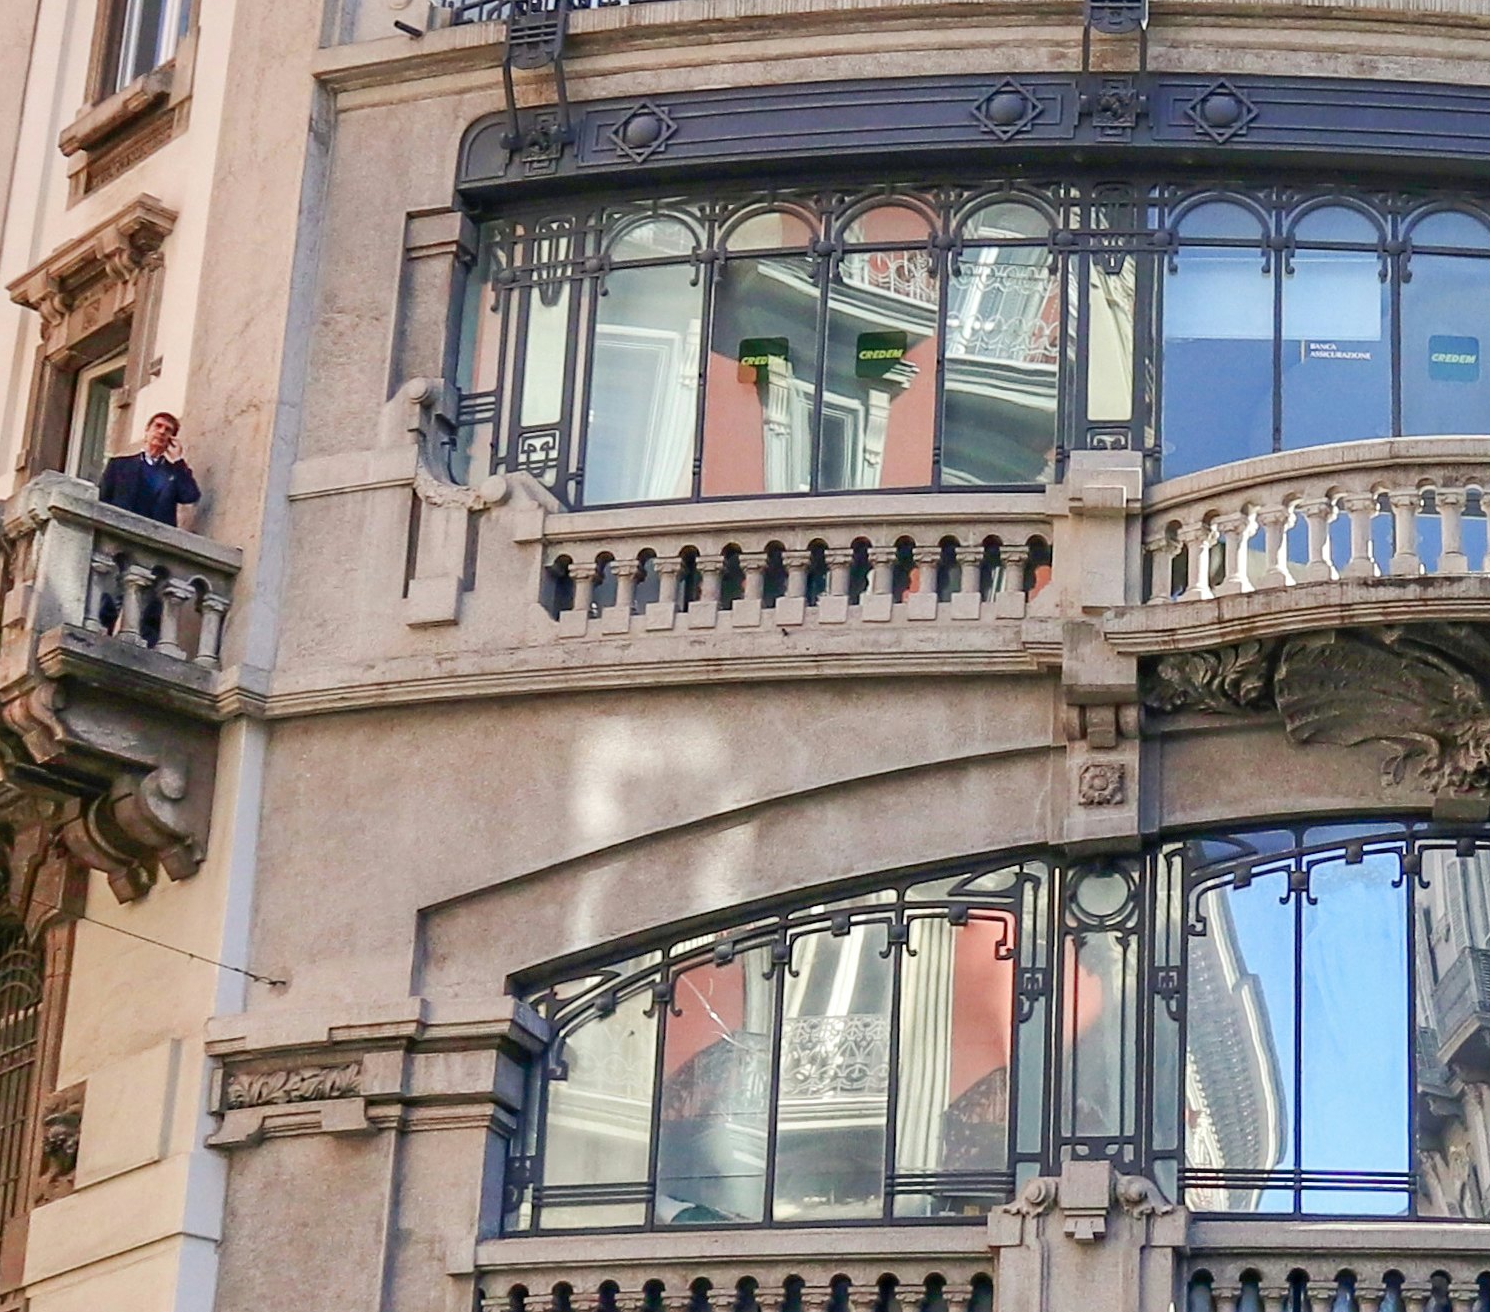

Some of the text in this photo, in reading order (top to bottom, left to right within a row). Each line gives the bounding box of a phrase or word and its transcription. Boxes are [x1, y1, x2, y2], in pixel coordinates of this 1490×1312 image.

[1309, 342, 1338, 351] BANCA
[859, 348, 904, 361] CREDEM
[1310, 350, 1372, 361] ASSICURAZIONE
[1430, 352, 1477, 365] CREDEM
